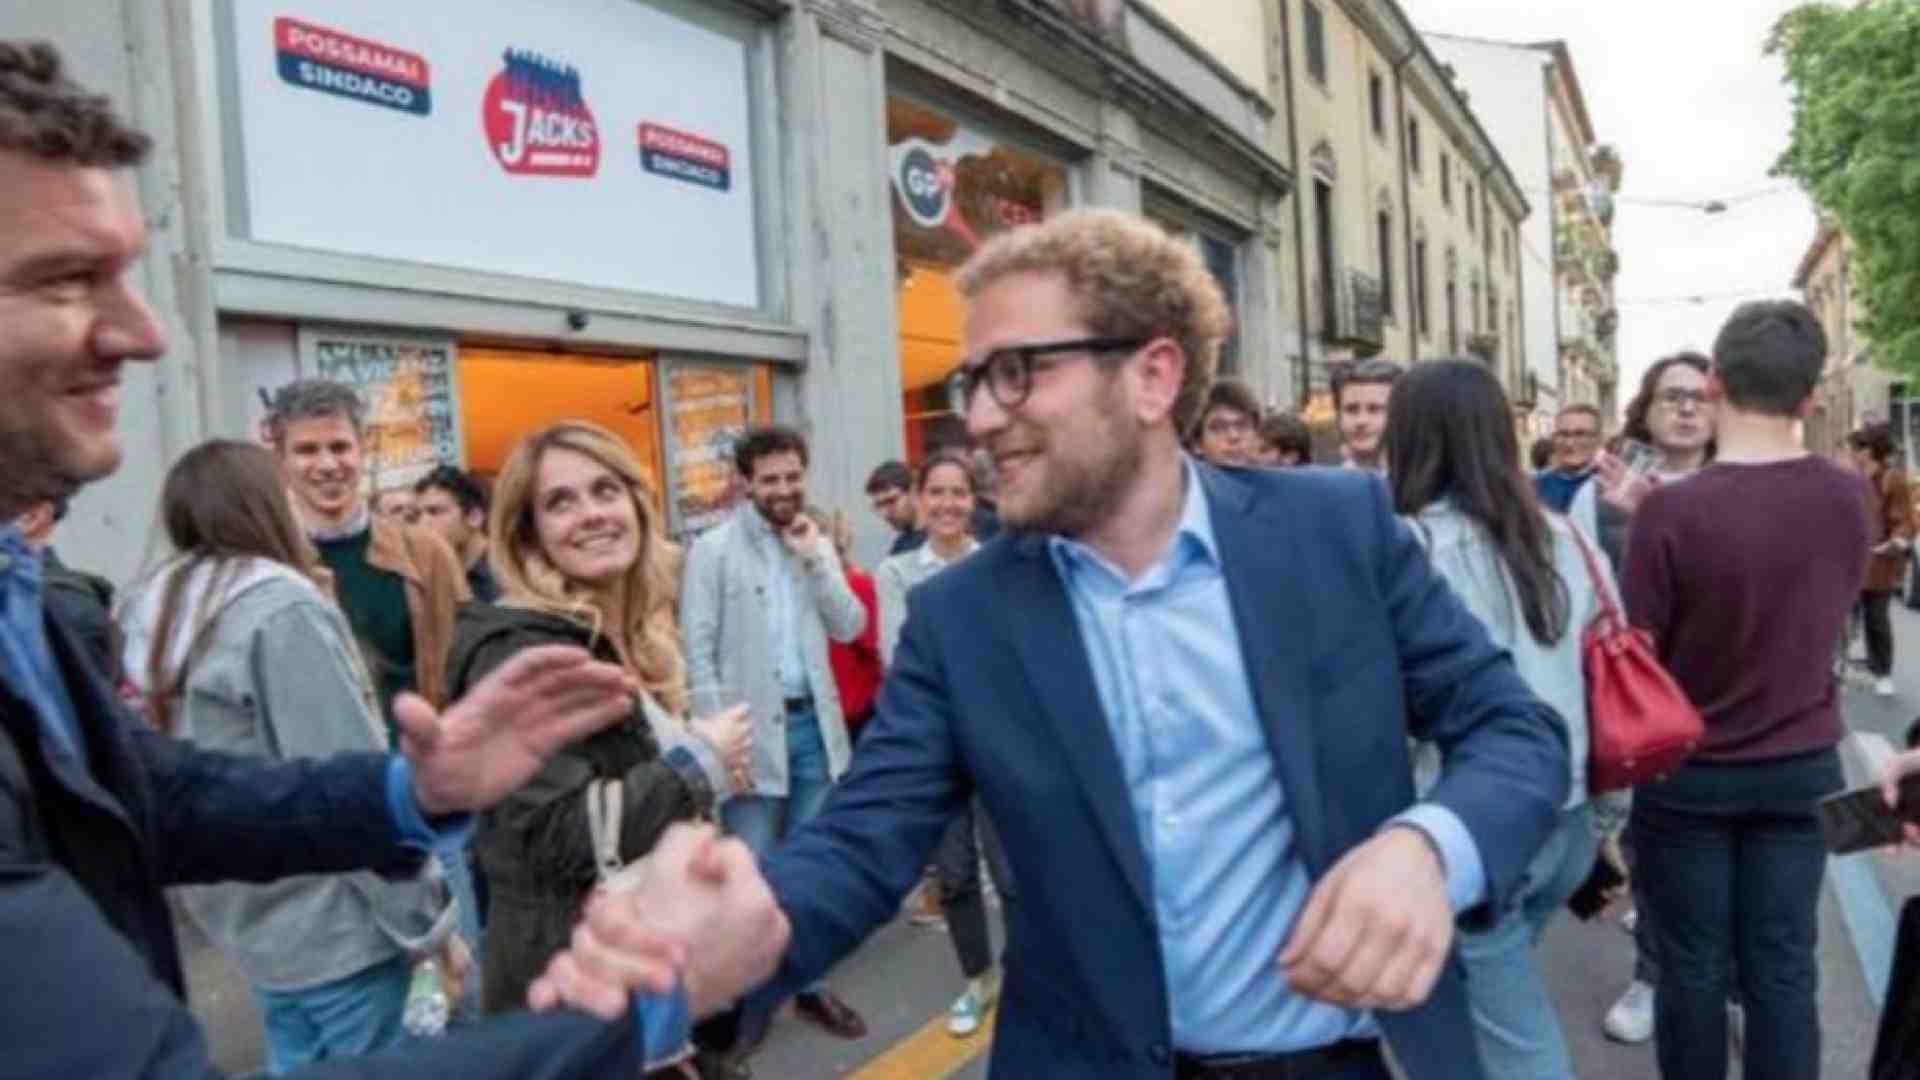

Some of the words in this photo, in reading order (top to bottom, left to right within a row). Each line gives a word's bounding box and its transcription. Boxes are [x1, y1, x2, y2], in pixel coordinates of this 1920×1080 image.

[287, 28, 419, 80] POSSAMAI
[299, 60, 414, 106] SINDACO
[499, 99, 594, 163] JACKS
